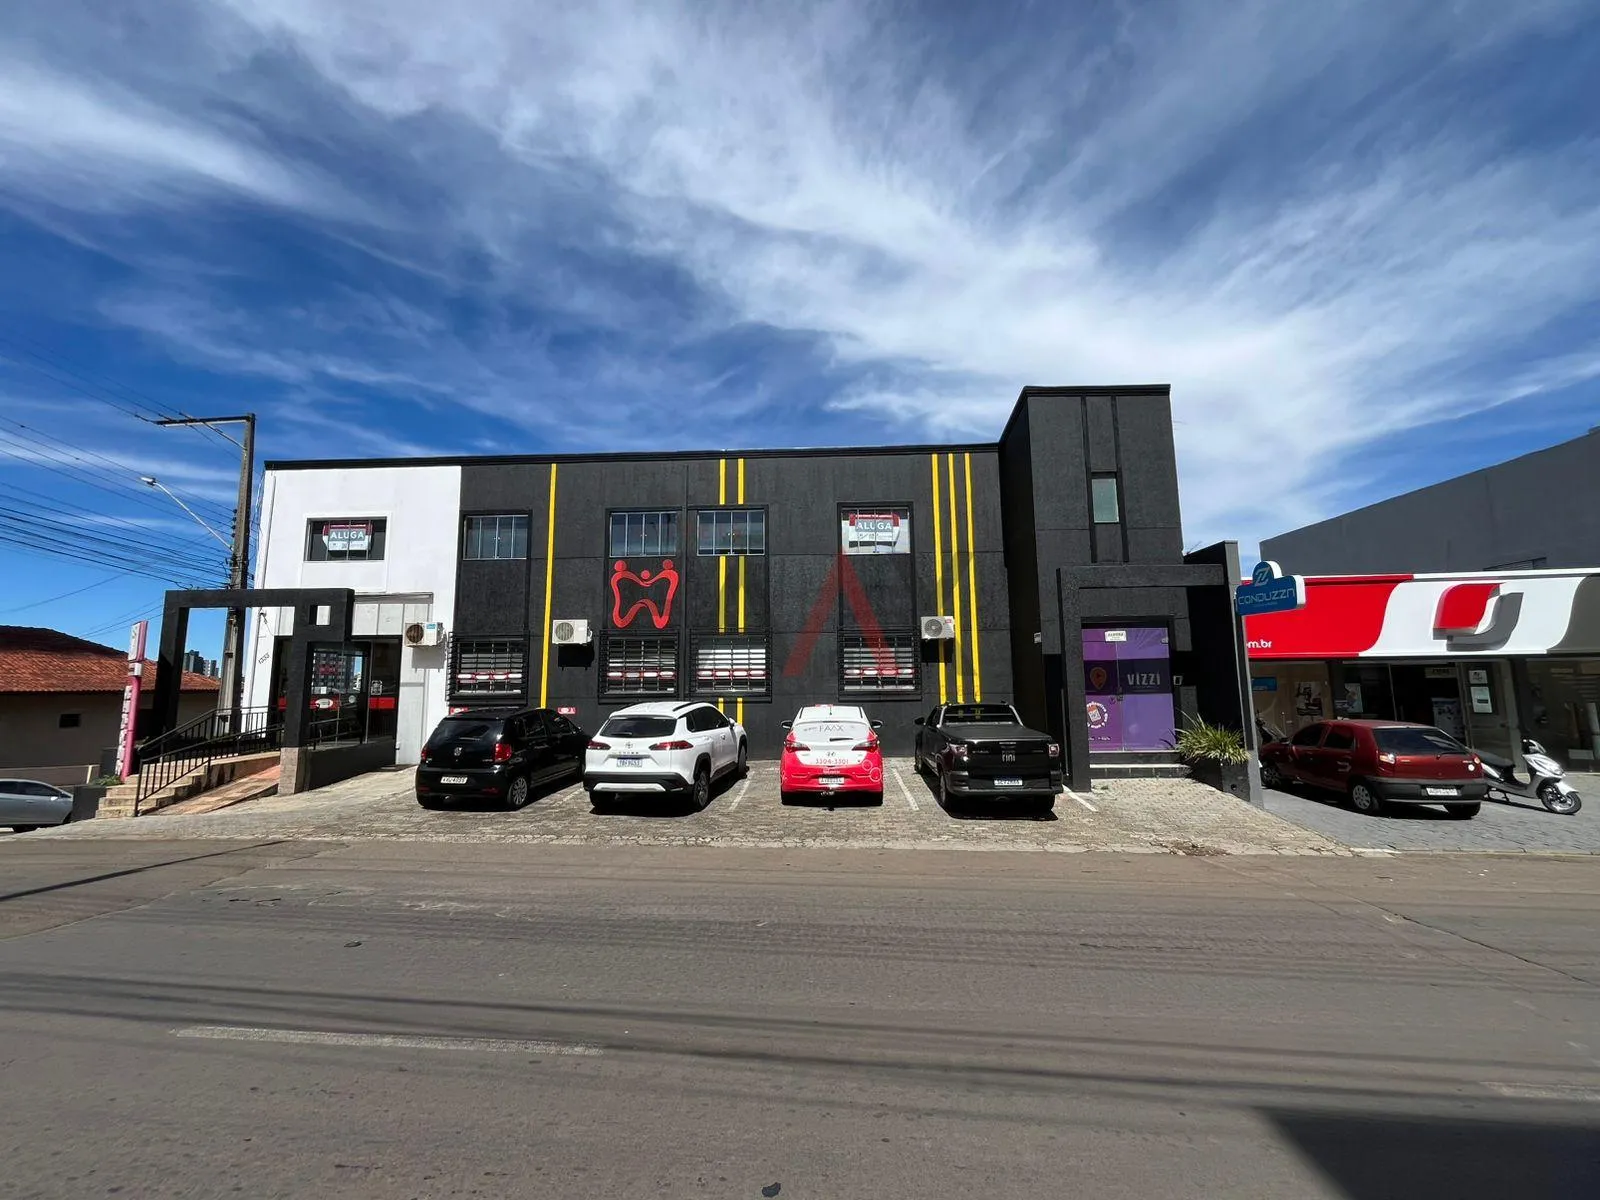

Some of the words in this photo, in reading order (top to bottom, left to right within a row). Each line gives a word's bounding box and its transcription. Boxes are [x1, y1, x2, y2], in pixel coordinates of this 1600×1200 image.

[857, 519, 892, 530] ALUGA
[330, 531, 365, 539] ALUGA
[1127, 672, 1161, 686] VIZZI
